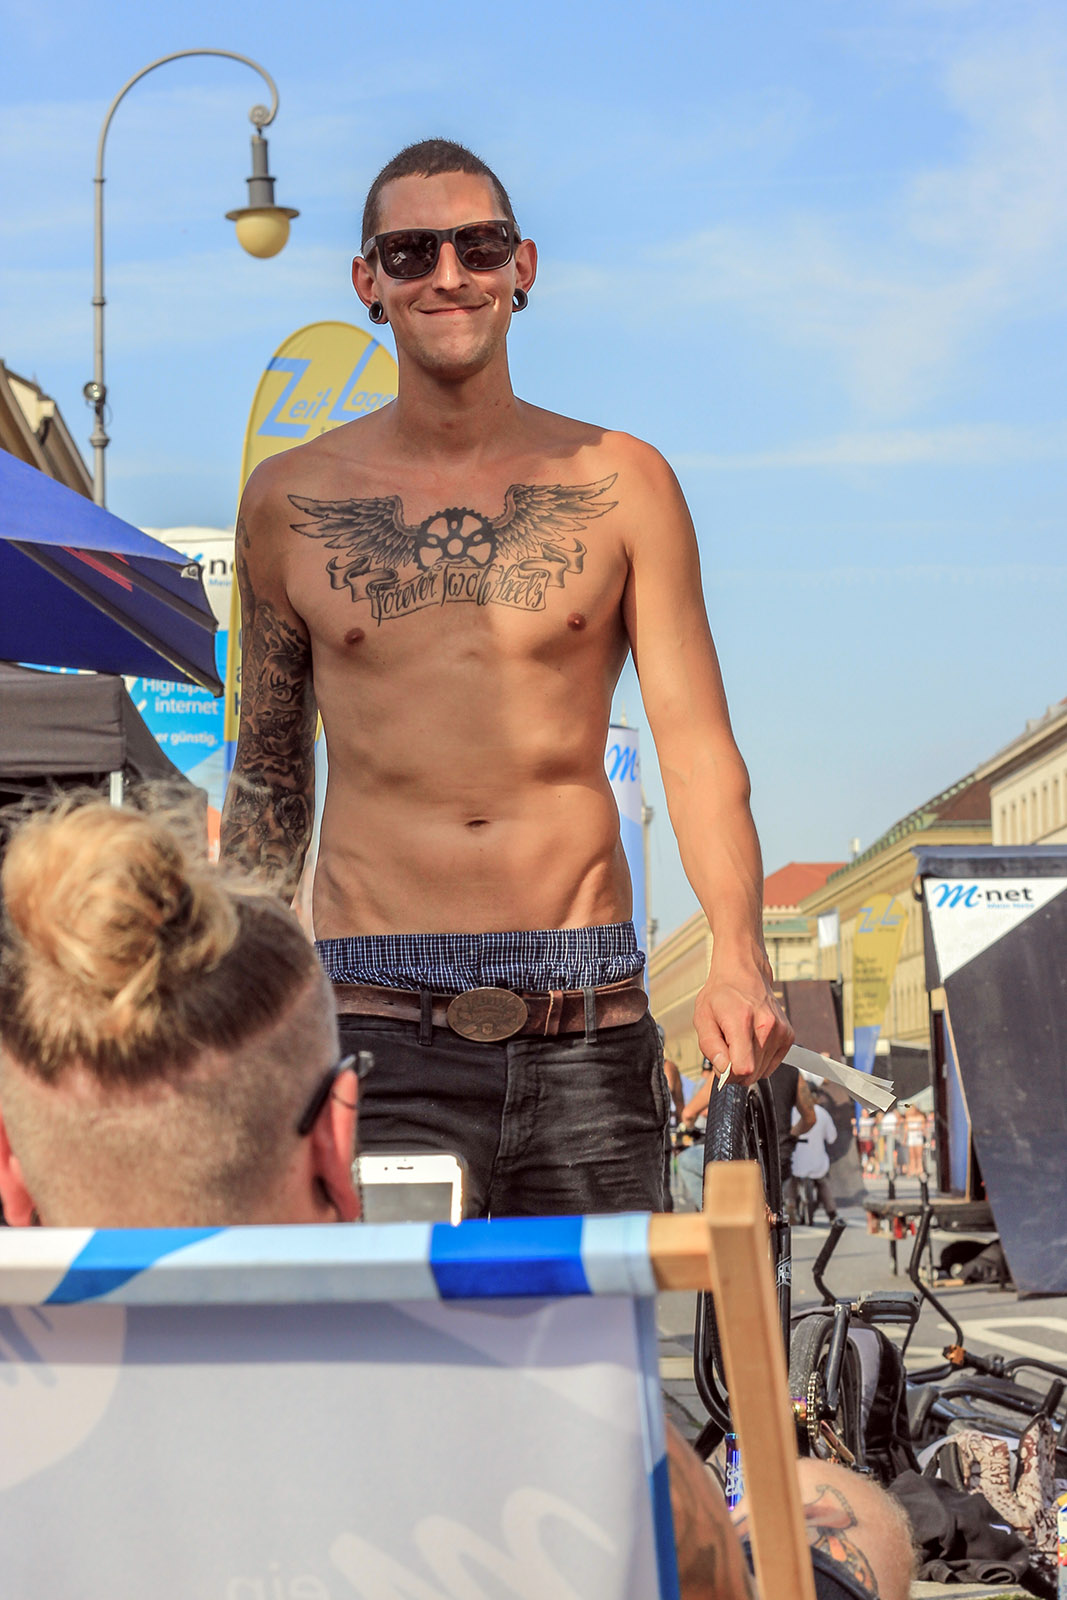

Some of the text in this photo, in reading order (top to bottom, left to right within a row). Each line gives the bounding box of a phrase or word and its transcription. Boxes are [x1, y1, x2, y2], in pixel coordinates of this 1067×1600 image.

[256, 338, 395, 439] Zeit Lage
[369, 569, 440, 627] Forever
[154, 696, 219, 715] internet
